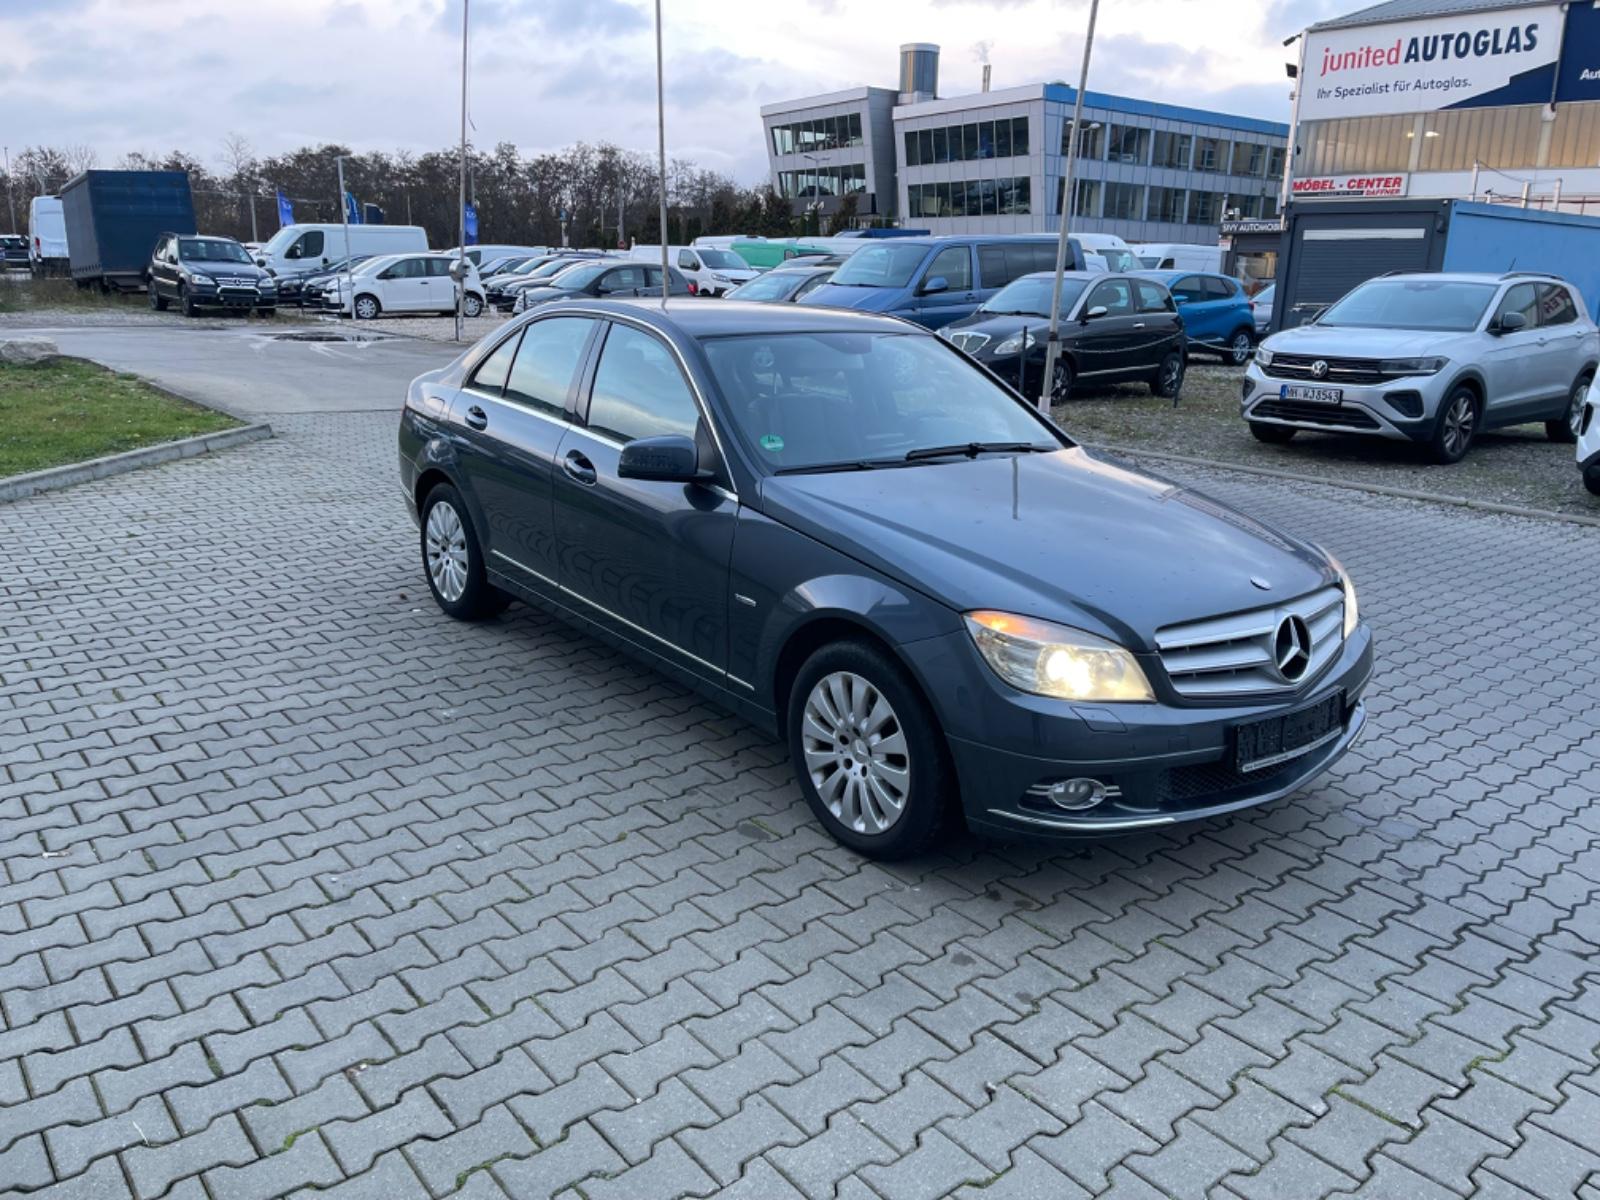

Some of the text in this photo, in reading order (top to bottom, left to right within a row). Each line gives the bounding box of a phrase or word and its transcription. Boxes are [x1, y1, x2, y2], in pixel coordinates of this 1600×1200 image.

[1320, 23, 1538, 77] junited AUTOGLAS
[1316, 77, 1472, 100] Ihr Spezialist für Autoglas.
[1292, 177, 1336, 192] MÖBEL
[1347, 176, 1403, 190] CENTER
